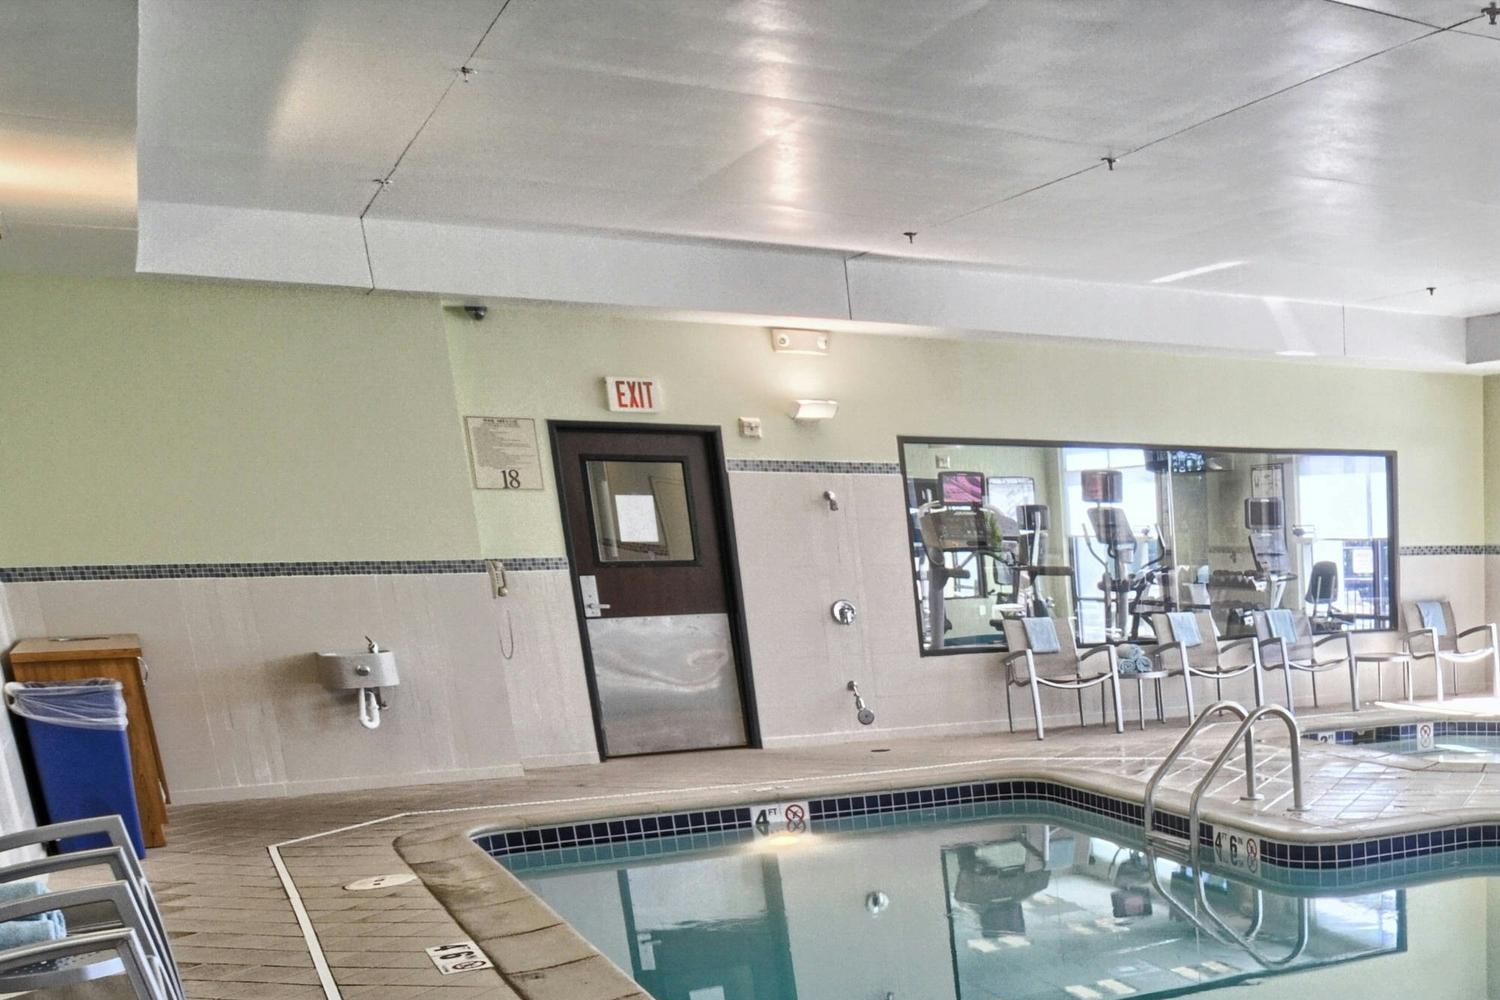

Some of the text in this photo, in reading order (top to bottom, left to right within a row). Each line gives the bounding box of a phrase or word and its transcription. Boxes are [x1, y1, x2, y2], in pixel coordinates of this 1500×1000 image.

[615, 380, 653, 409] EXIT
[501, 469, 521, 489] 18
[755, 809, 769, 825] 4
[1215, 832, 1223, 847] 4
[1230, 835, 1238, 852] 6
